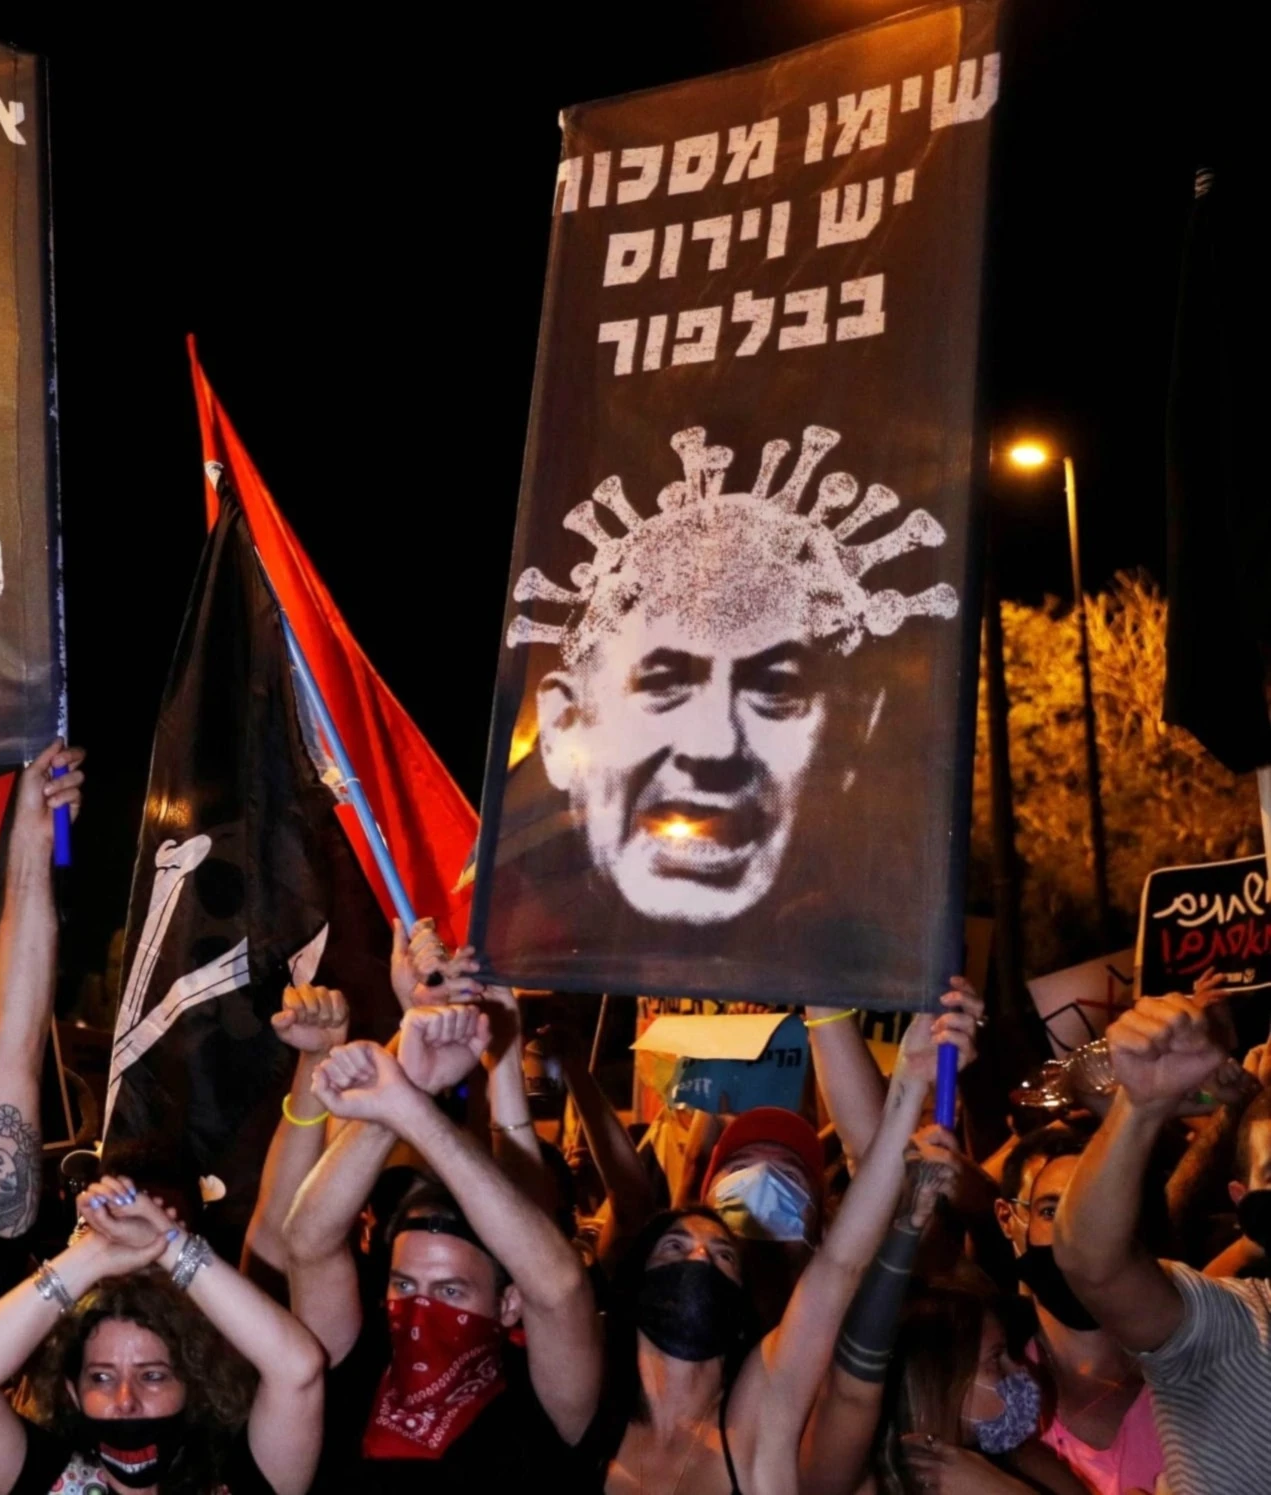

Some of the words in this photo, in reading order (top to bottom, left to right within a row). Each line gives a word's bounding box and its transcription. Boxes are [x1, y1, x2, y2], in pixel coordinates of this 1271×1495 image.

[804, 52, 1001, 164] שימו
[603, 201, 790, 287] וירוס
[817, 169, 916, 249] יש
[598, 273, 886, 376] בבלפור
